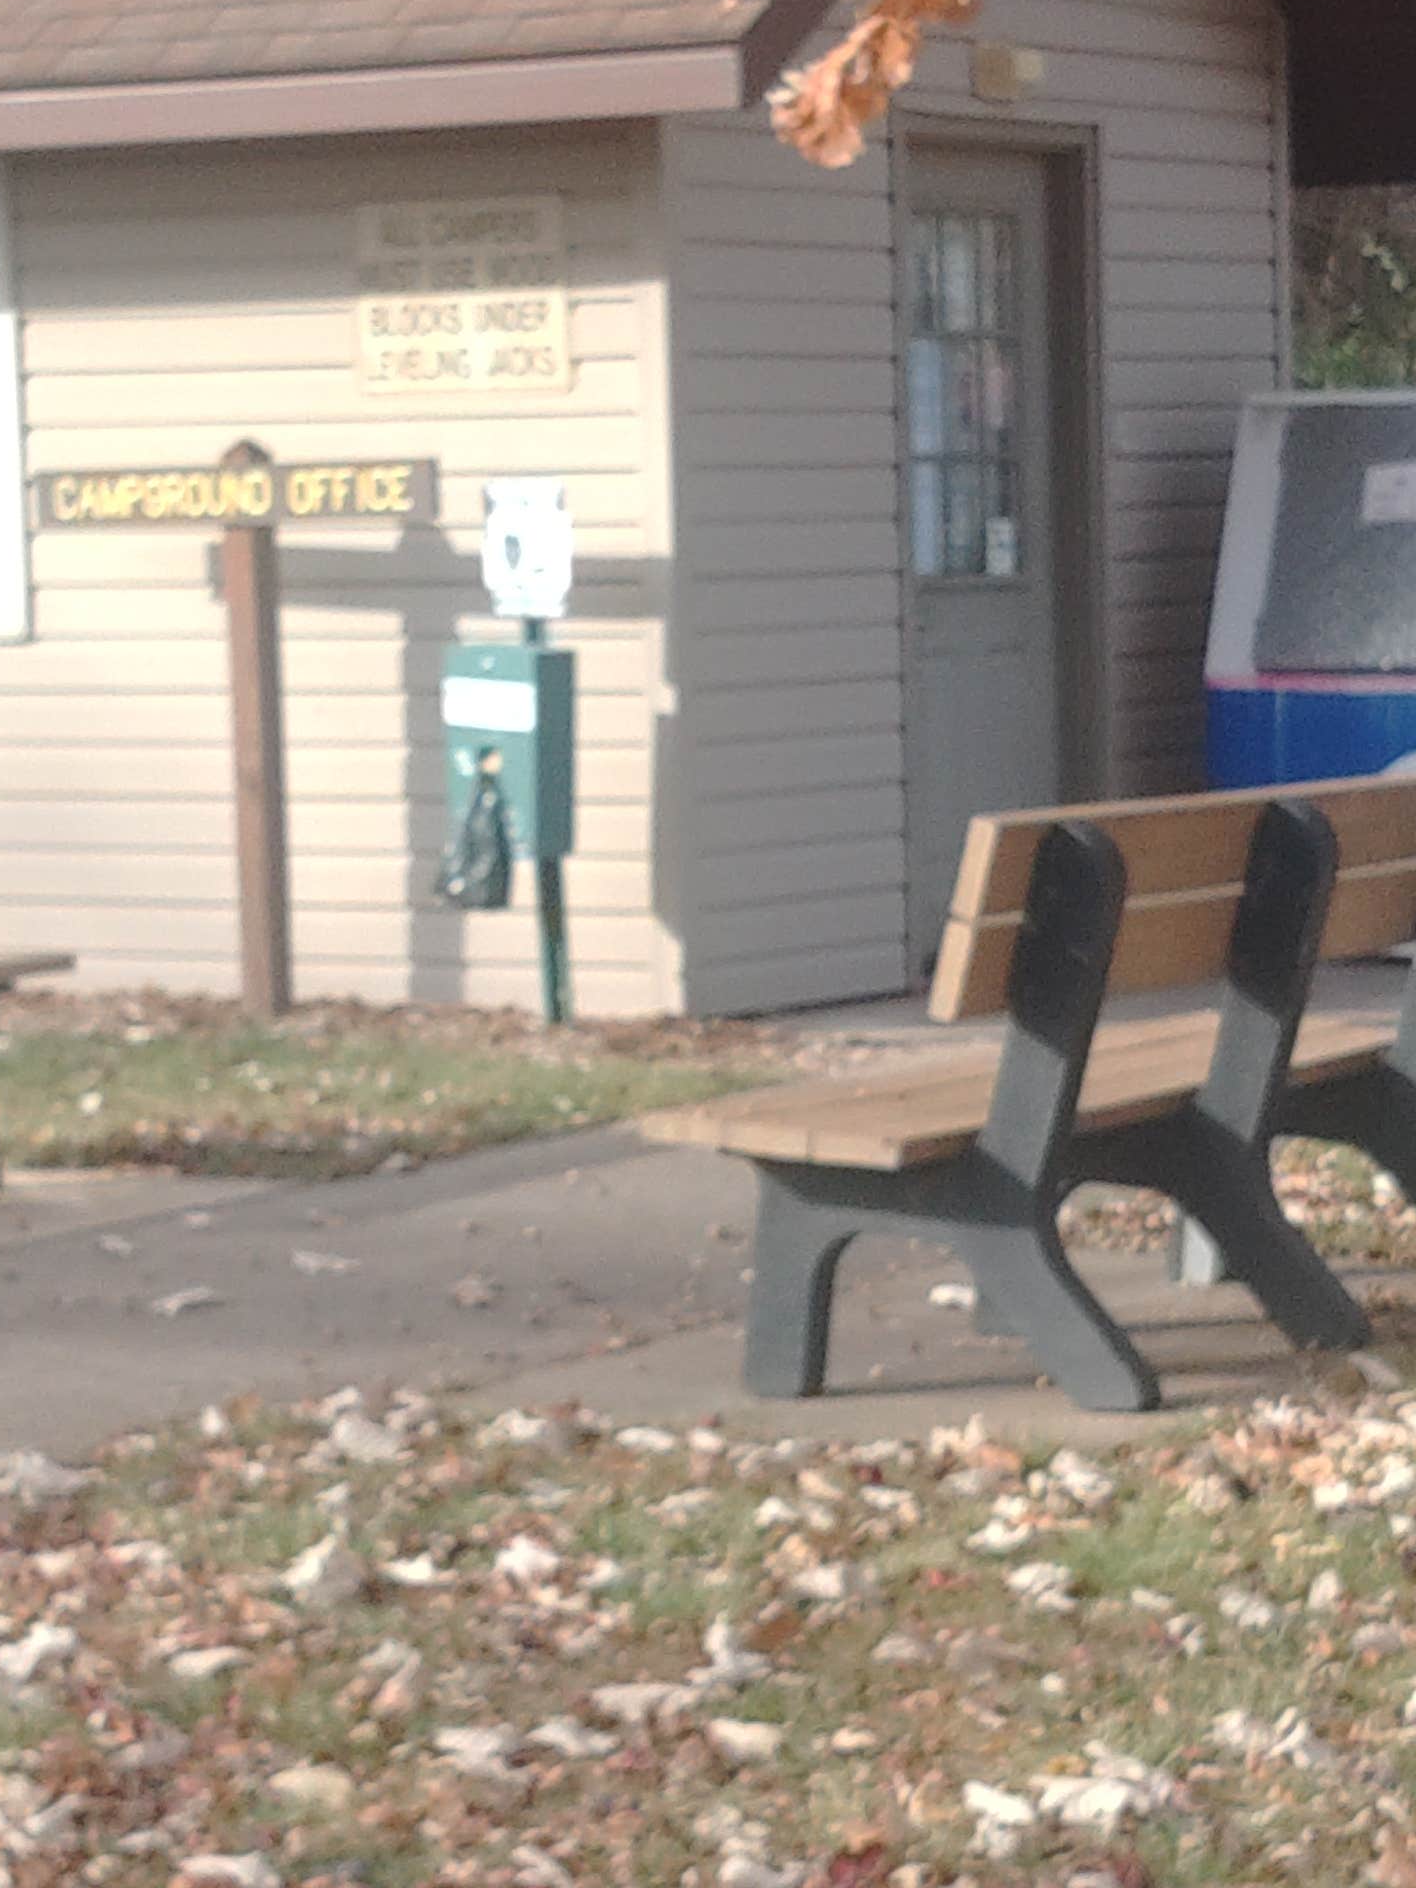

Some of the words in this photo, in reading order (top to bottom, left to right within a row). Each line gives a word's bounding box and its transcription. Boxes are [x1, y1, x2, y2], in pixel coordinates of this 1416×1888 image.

[370, 302, 463, 338] BLOCKS
[474, 298, 551, 333] UNDER
[367, 348, 472, 382] LEVELING
[488, 344, 557, 378] JACKS
[52, 469, 275, 521] CAMPGROUND
[287, 464, 415, 515] OFFICE
